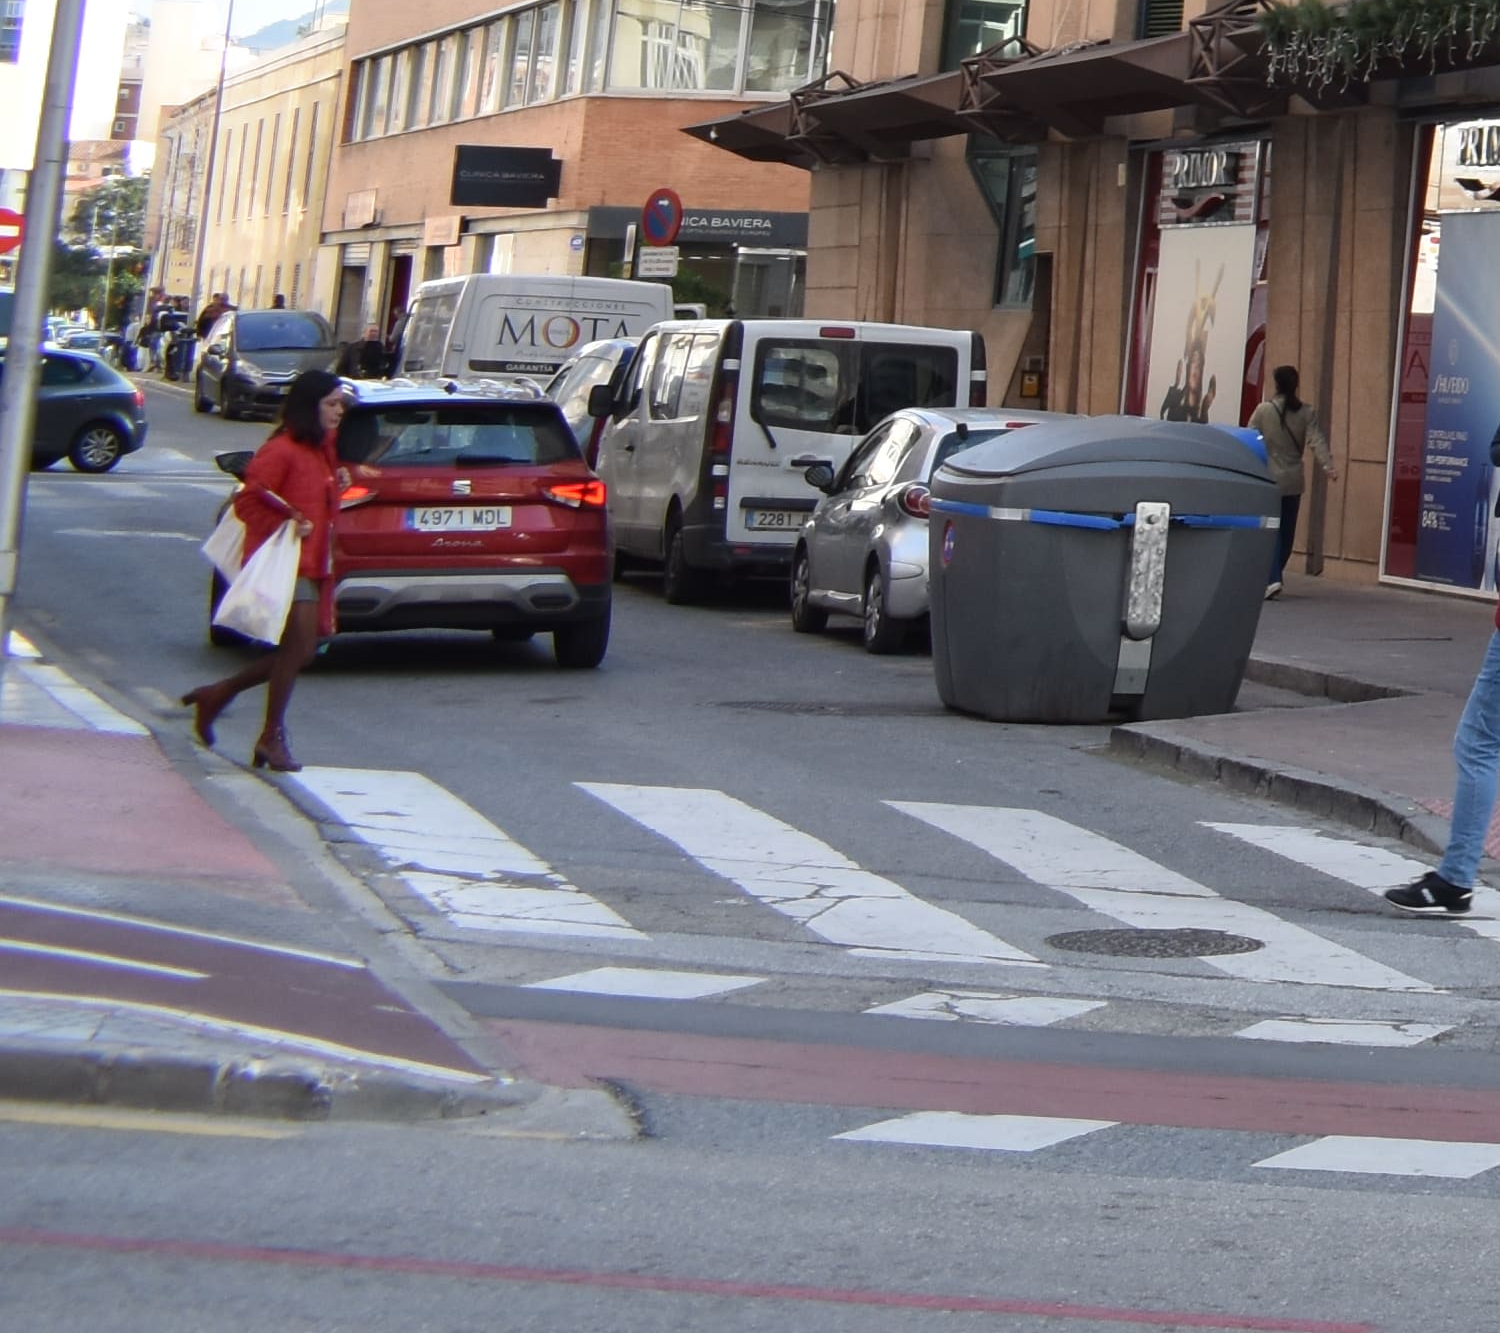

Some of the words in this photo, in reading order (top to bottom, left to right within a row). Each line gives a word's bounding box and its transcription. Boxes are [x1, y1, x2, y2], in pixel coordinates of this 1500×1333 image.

[1172, 151, 1226, 188] PRIMOR
[711, 217, 772, 229] BAVIERA
[496, 313, 629, 349] MOTA
[420, 510, 463, 525] 4971
[473, 509, 507, 525] MDL
[758, 513, 791, 526] 2281
